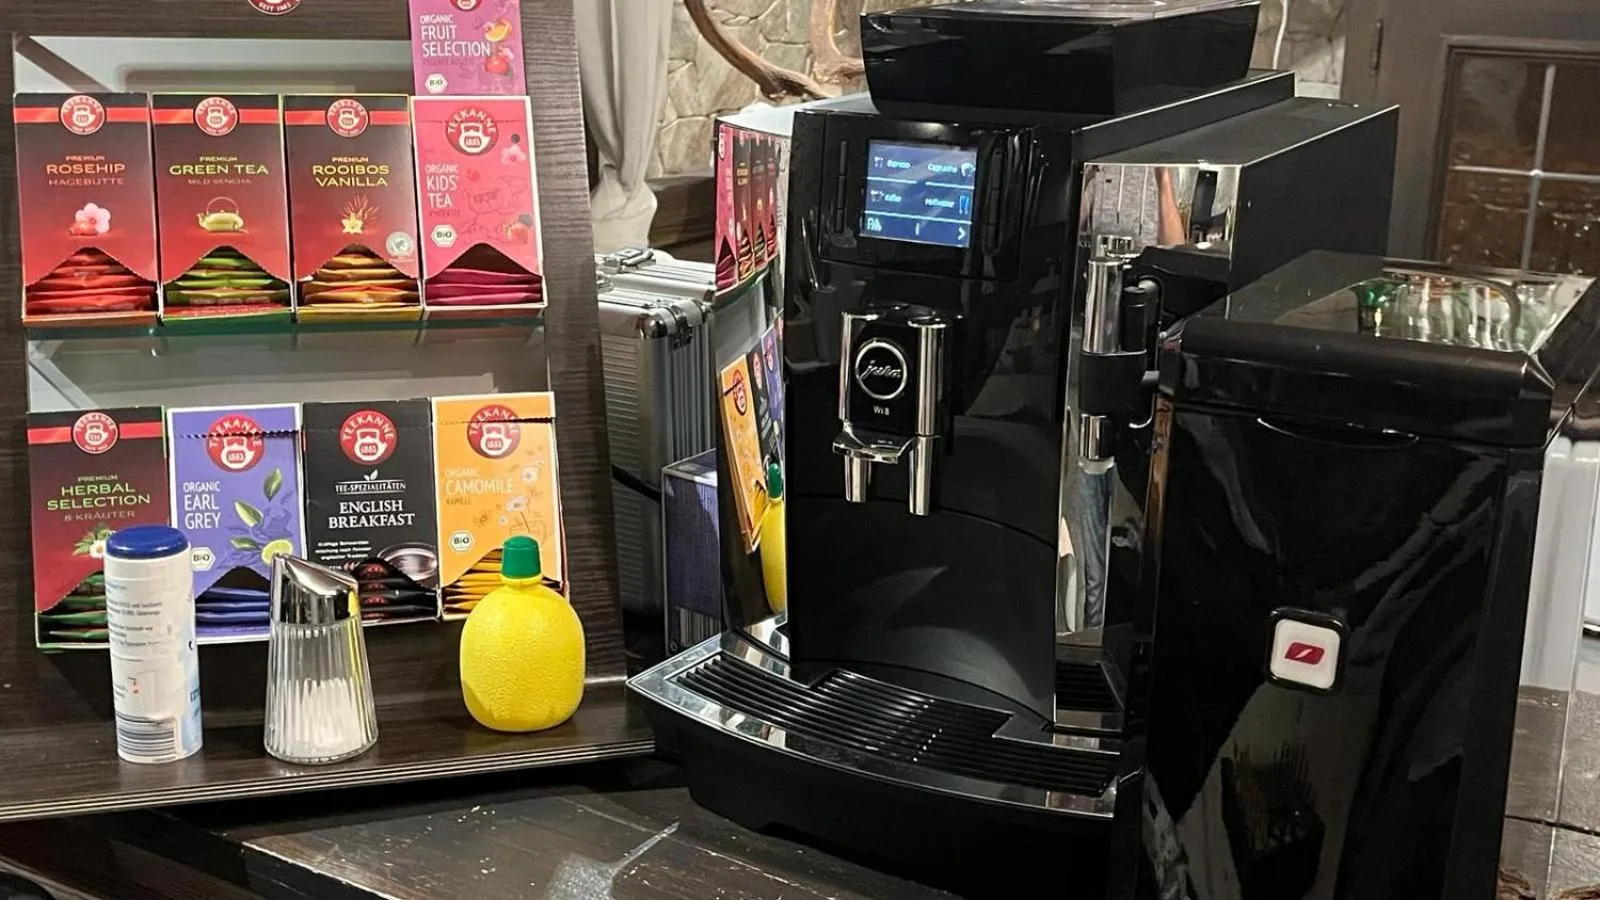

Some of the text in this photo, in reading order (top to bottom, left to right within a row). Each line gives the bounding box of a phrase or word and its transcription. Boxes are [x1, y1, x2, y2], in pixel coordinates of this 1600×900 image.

[420, 14, 454, 24] ORGANIC
[421, 25, 457, 40] FRUIT
[422, 41, 492, 57] SELECTION
[46, 163, 126, 174] ROSEHIP
[169, 164, 269, 175] GREEN TEA
[312, 164, 391, 175] ROOIBOS
[425, 163, 459, 174] ORGANIC
[48, 177, 125, 186] HAGEBUTTE
[315, 176, 389, 187] VANILLA
[427, 192, 453, 209] TEA
[859, 360, 902, 380] jura
[342, 414, 395, 441] TEEKANNE
[61, 482, 136, 496] HERBAL
[183, 480, 221, 493] ORGANIC
[335, 481, 407, 493] TEE-SPEZIALITÄTEN
[446, 478, 516, 496] CAMOMILE
[46, 493, 151, 512] SELECTION
[184, 493, 220, 511] EARL
[339, 499, 403, 514] ENGLISH
[75, 510, 136, 520] KRÄUTER
[185, 511, 221, 530] GREY
[328, 512, 416, 529] BREAKFAST
